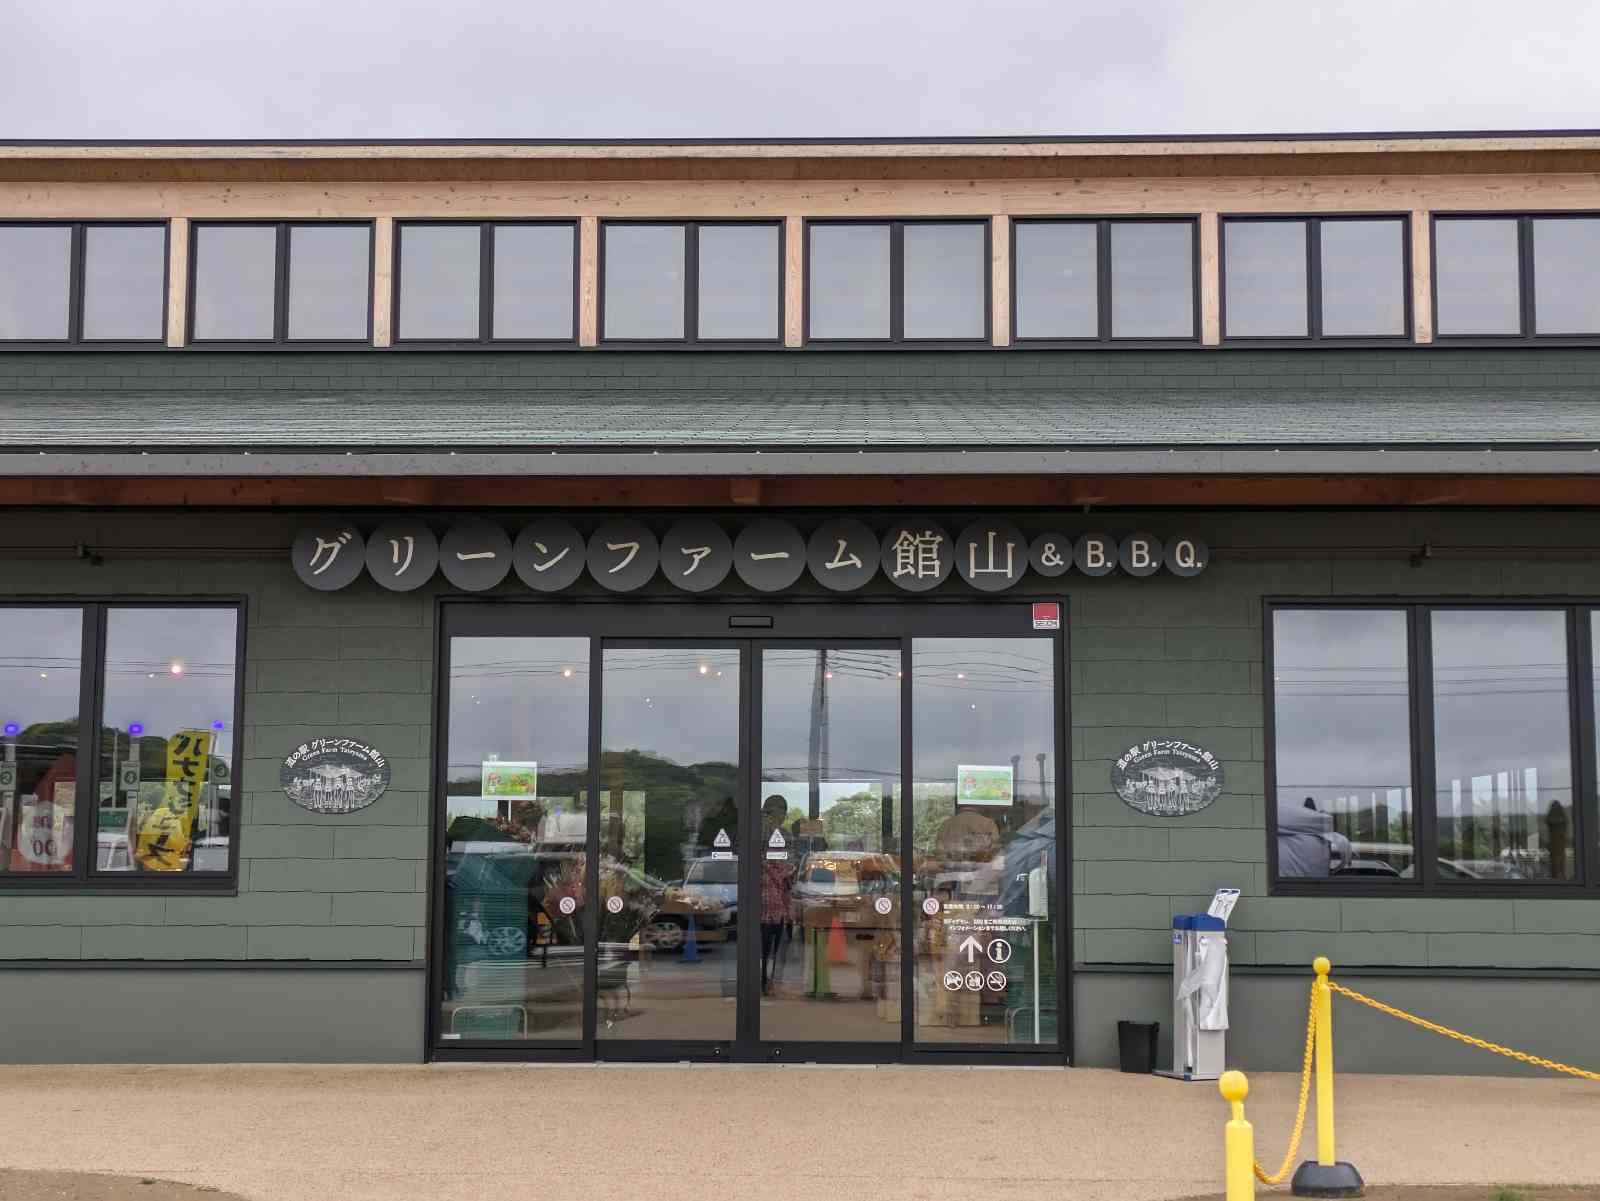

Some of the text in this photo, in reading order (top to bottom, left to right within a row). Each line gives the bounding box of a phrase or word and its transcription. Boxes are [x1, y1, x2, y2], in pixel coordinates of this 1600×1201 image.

[308, 531, 1016, 579] グリーンファーム館山
